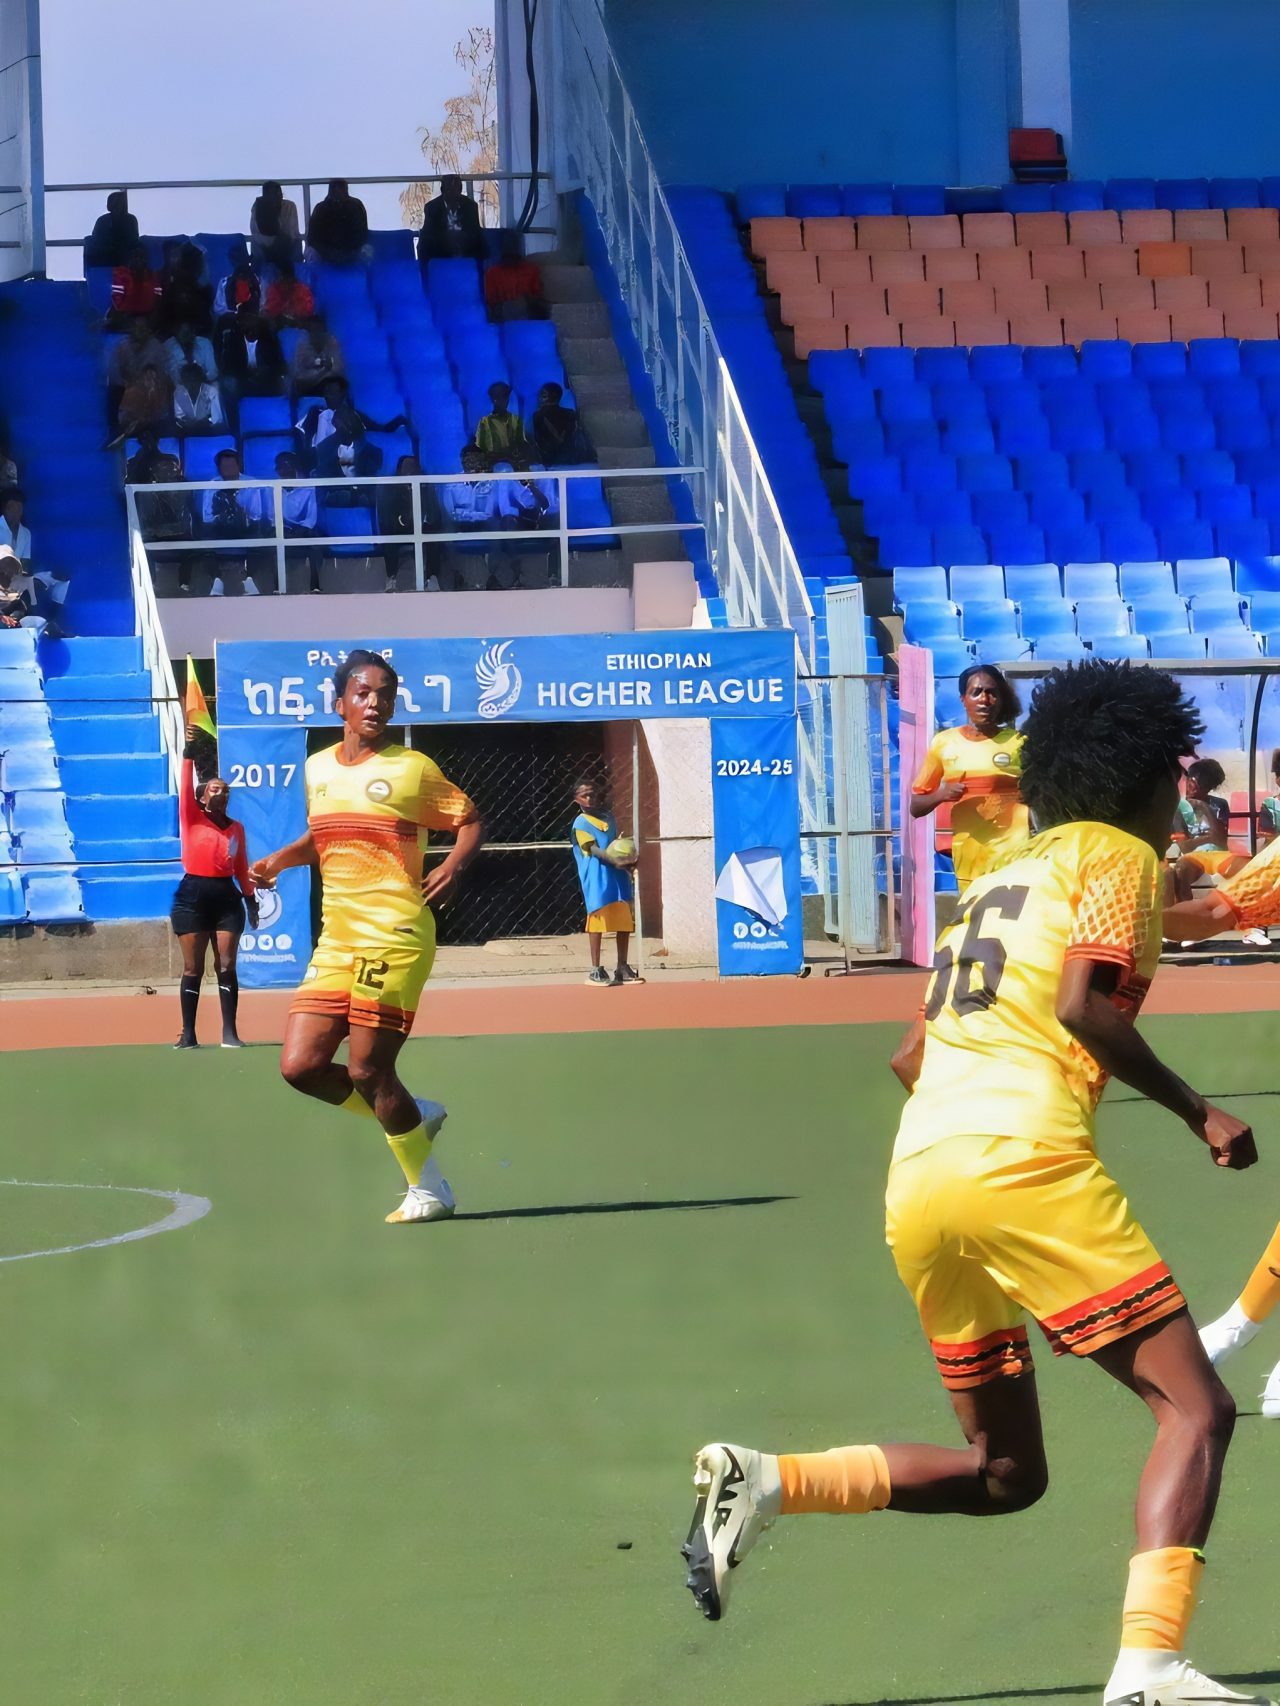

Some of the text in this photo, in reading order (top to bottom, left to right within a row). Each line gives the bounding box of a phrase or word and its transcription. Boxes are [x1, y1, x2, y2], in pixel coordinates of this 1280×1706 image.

[606, 653, 712, 671] ETHIOPIAN
[243, 676, 336, 721] ከፍተ
[537, 678, 784, 708] HIGHER LEAGUE
[229, 764, 297, 789] 2017
[716, 759, 793, 777] 2024-25
